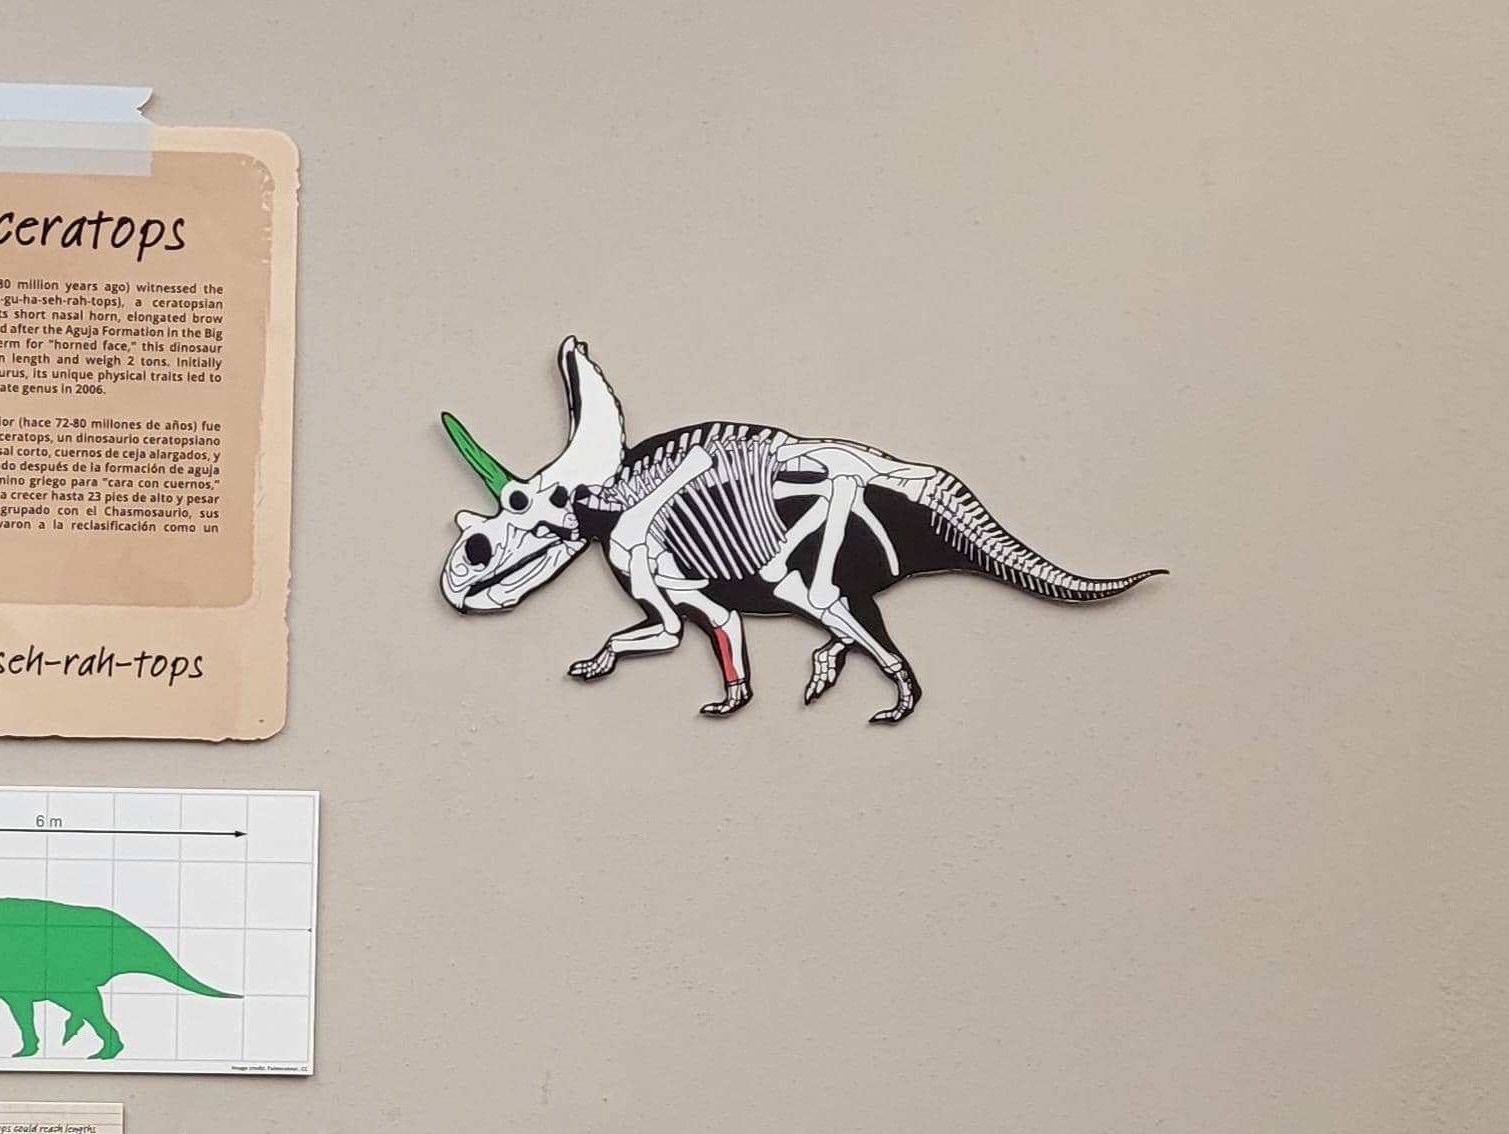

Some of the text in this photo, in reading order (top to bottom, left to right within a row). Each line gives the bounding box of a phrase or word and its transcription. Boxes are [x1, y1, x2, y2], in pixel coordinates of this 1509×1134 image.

[17, 279, 59, 290] million
[65, 282, 98, 294] years
[104, 282, 130, 294] ago)
[136, 282, 197, 294] witnessed
[203, 283, 223, 294] the
[134, 299, 142, 307] a
[152, 298, 223, 311] ceratopsian
[13, 308, 46, 320] short
[51, 309, 83, 321] nasal
[89, 309, 121, 323] horn,
[126, 311, 186, 325] elongated
[192, 312, 223, 324] brow
[9, 323, 40, 334] after
[42, 323, 63, 335] the
[65, 324, 99, 338] Aguja
[102, 325, 164, 337] Formation
[167, 327, 178, 338] in
[181, 327, 202, 338] the
[204, 327, 223, 342] Big
[26, 338, 44, 349] for
[141, 341, 164, 352] this
[169, 341, 223, 353] dinosaur
[18, 416, 51, 429] (hace
[55, 417, 87, 428] 72-80
[91, 418, 142, 430] millones
[145, 419, 161, 430] de
[164, 419, 197, 433] años)
[201, 420, 221, 432] fue
[57, 434, 72, 443] un
[75, 432, 140, 444] dinosaurio
[142, 435, 220, 448] ceratopsiano
[57, 507, 79, 516] con
[86, 505, 97, 516] el
[104, 505, 192, 520] Chasmosaurio,
[199, 510, 219, 519] sus
[36, 814, 62, 828] 6 m
[13, 1124, 37, 1133] could
[39, 1124, 63, 1133] reach
[64, 1124, 97, 1134] lengths
